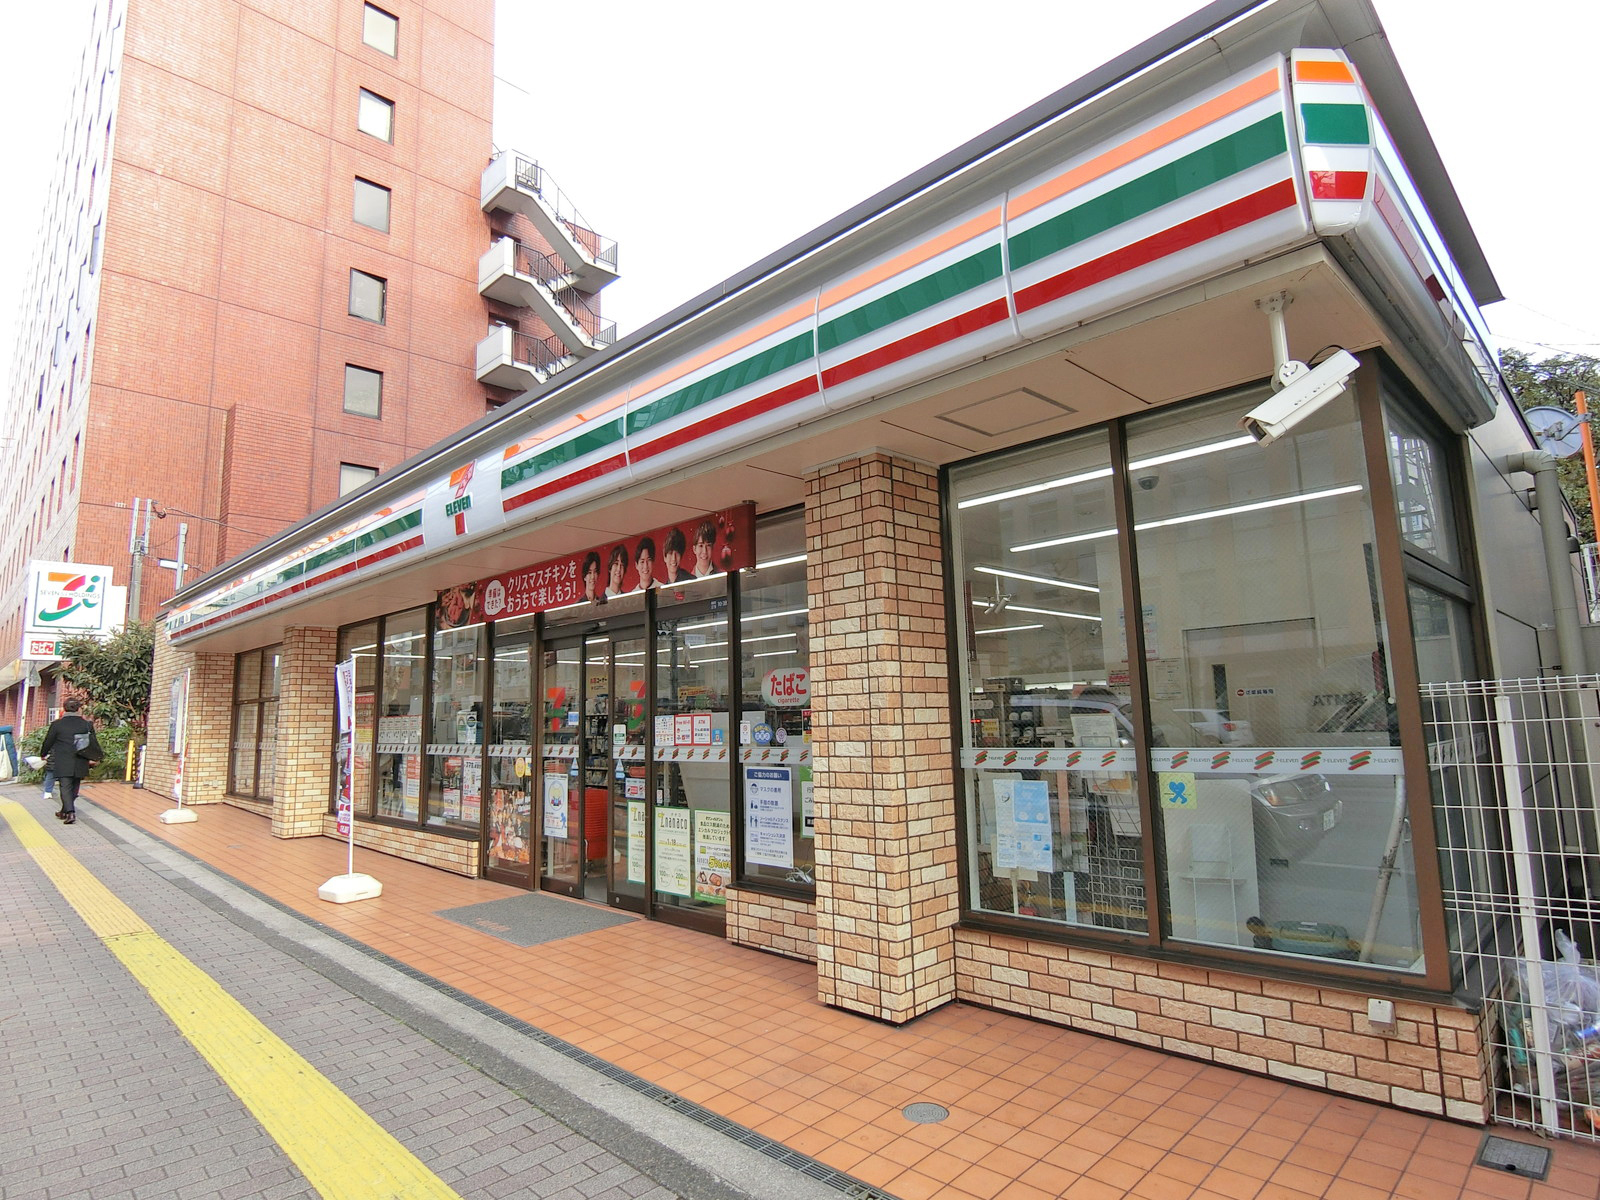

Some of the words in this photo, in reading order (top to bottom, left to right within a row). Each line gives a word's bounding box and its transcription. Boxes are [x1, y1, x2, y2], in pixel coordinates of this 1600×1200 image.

[507, 560, 577, 594] クリスマスチキンを
[506, 580, 577, 613] おうちで楽しもう!
[31, 642, 54, 654] たばこ
[770, 672, 807, 697] たばこ
[777, 697, 800, 705] cigarette
[665, 817, 688, 830] nanaco
